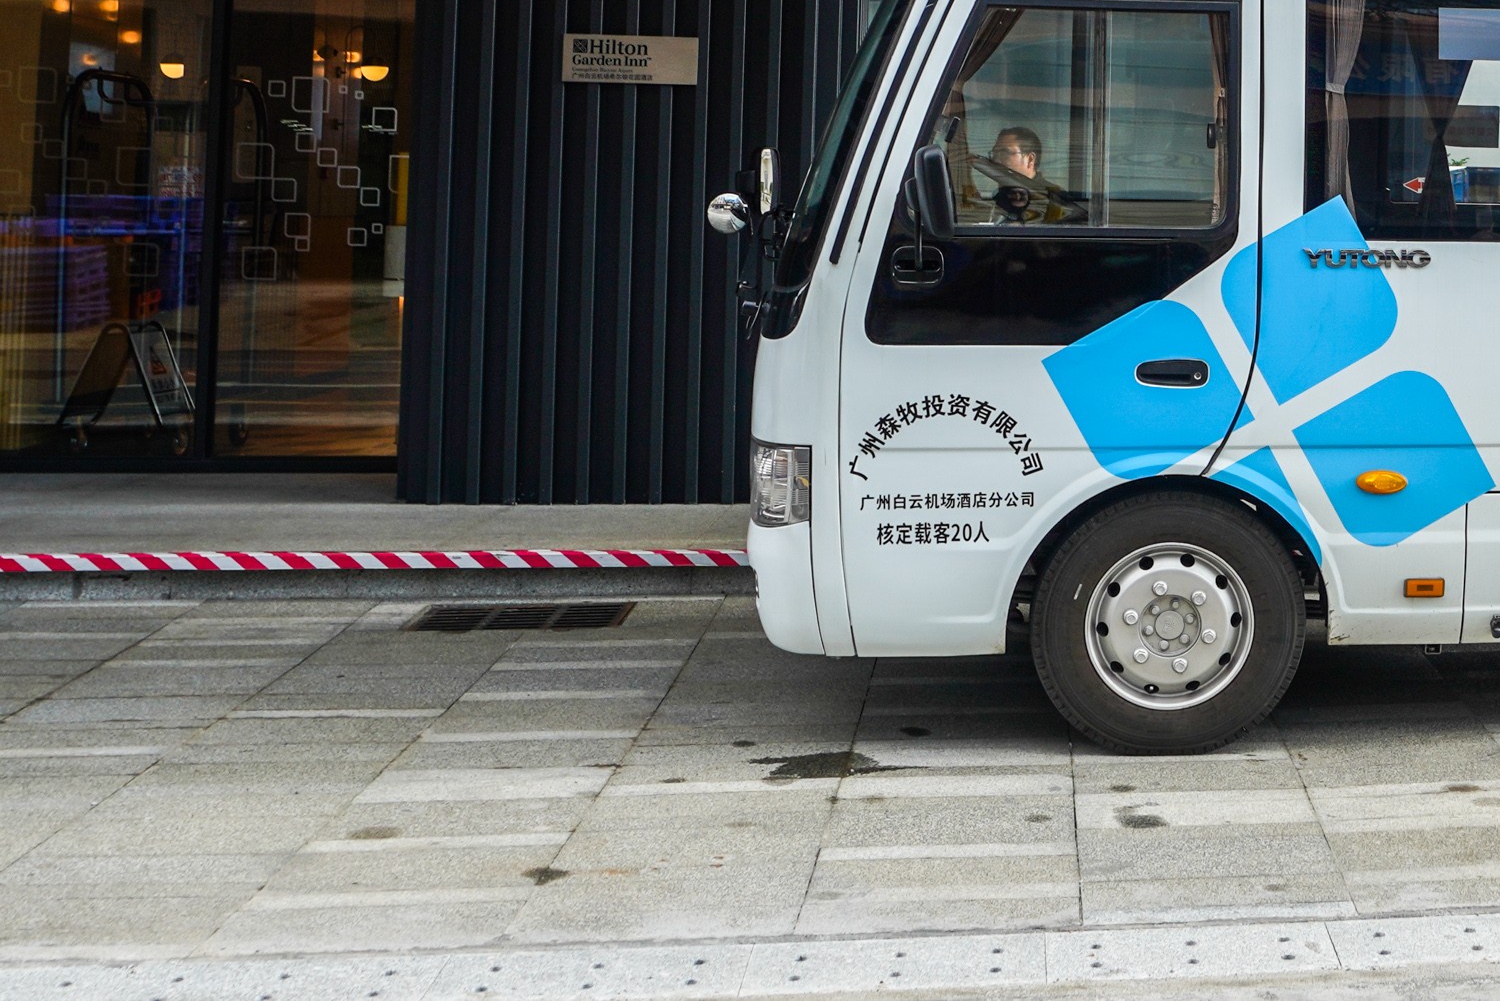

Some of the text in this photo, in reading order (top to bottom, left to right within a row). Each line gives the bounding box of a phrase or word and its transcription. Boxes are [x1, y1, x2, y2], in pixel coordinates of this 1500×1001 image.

[589, 39, 648, 55] Hilton
[572, 54, 621, 66] Garden
[1302, 248, 1431, 268] YUTONG
[849, 393, 1044, 481] 广州森牧投资有限公司
[860, 491, 1035, 511] 广州白云机场酒店分公司
[876, 520, 990, 546] 核定载客20人
